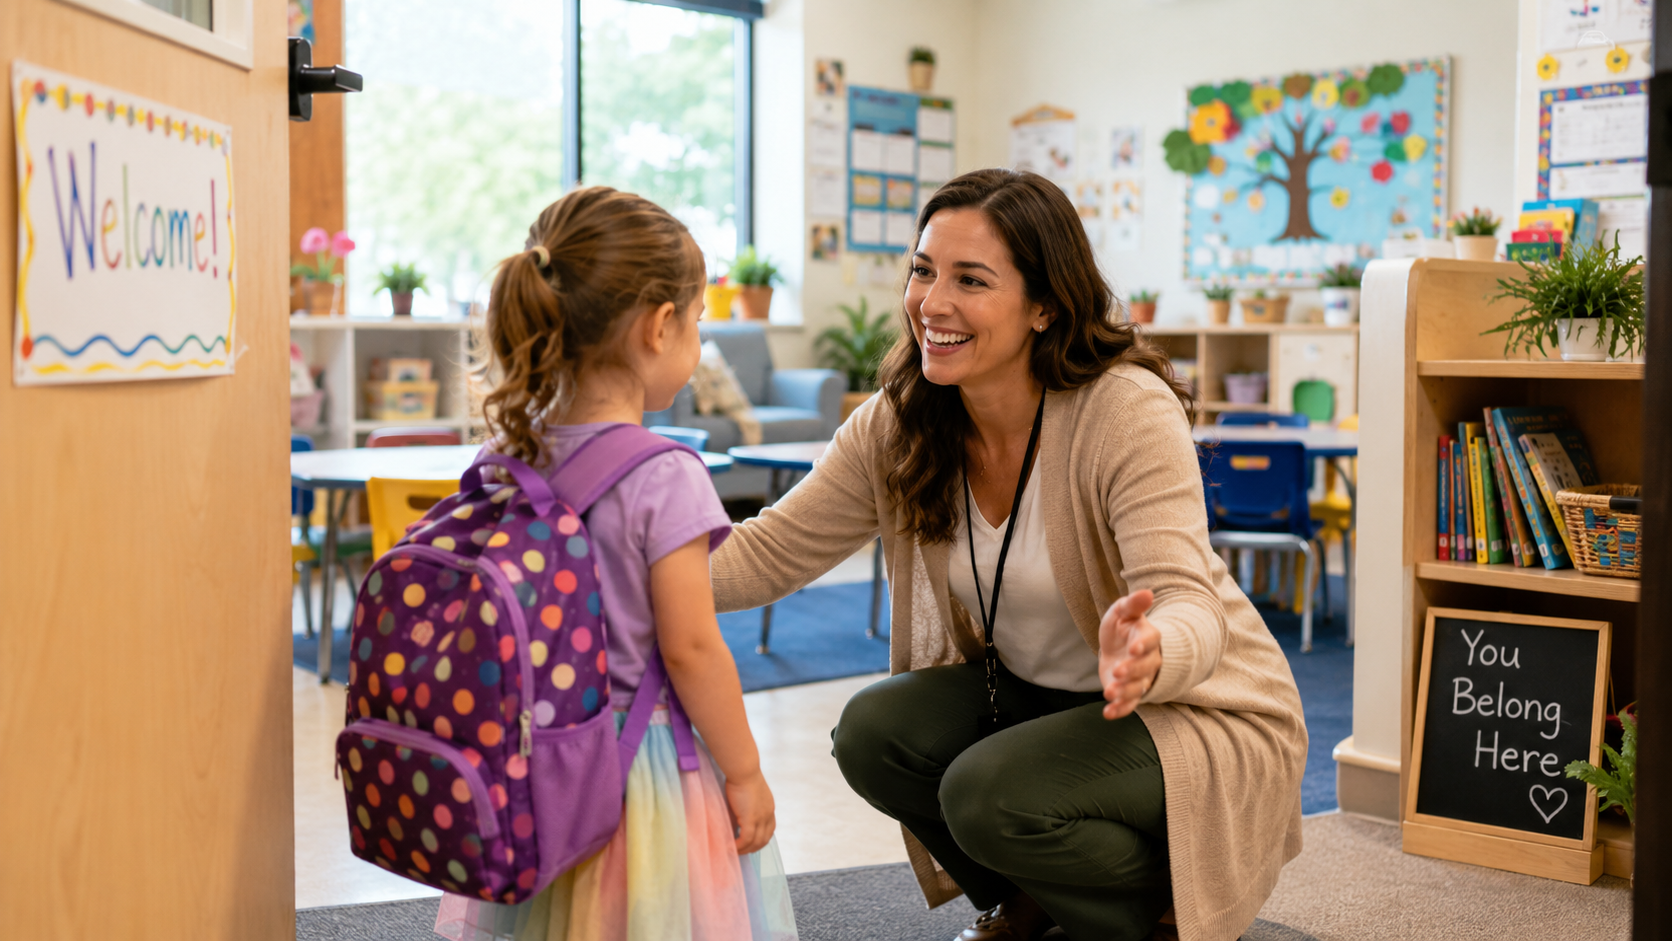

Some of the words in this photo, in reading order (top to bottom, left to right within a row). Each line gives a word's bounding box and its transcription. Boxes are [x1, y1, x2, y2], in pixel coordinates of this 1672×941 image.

[47, 140, 219, 281] Welcome!
[1461, 628, 1520, 669] You
[1452, 676, 1561, 740] Belong
[1474, 729, 1561, 777] Here
